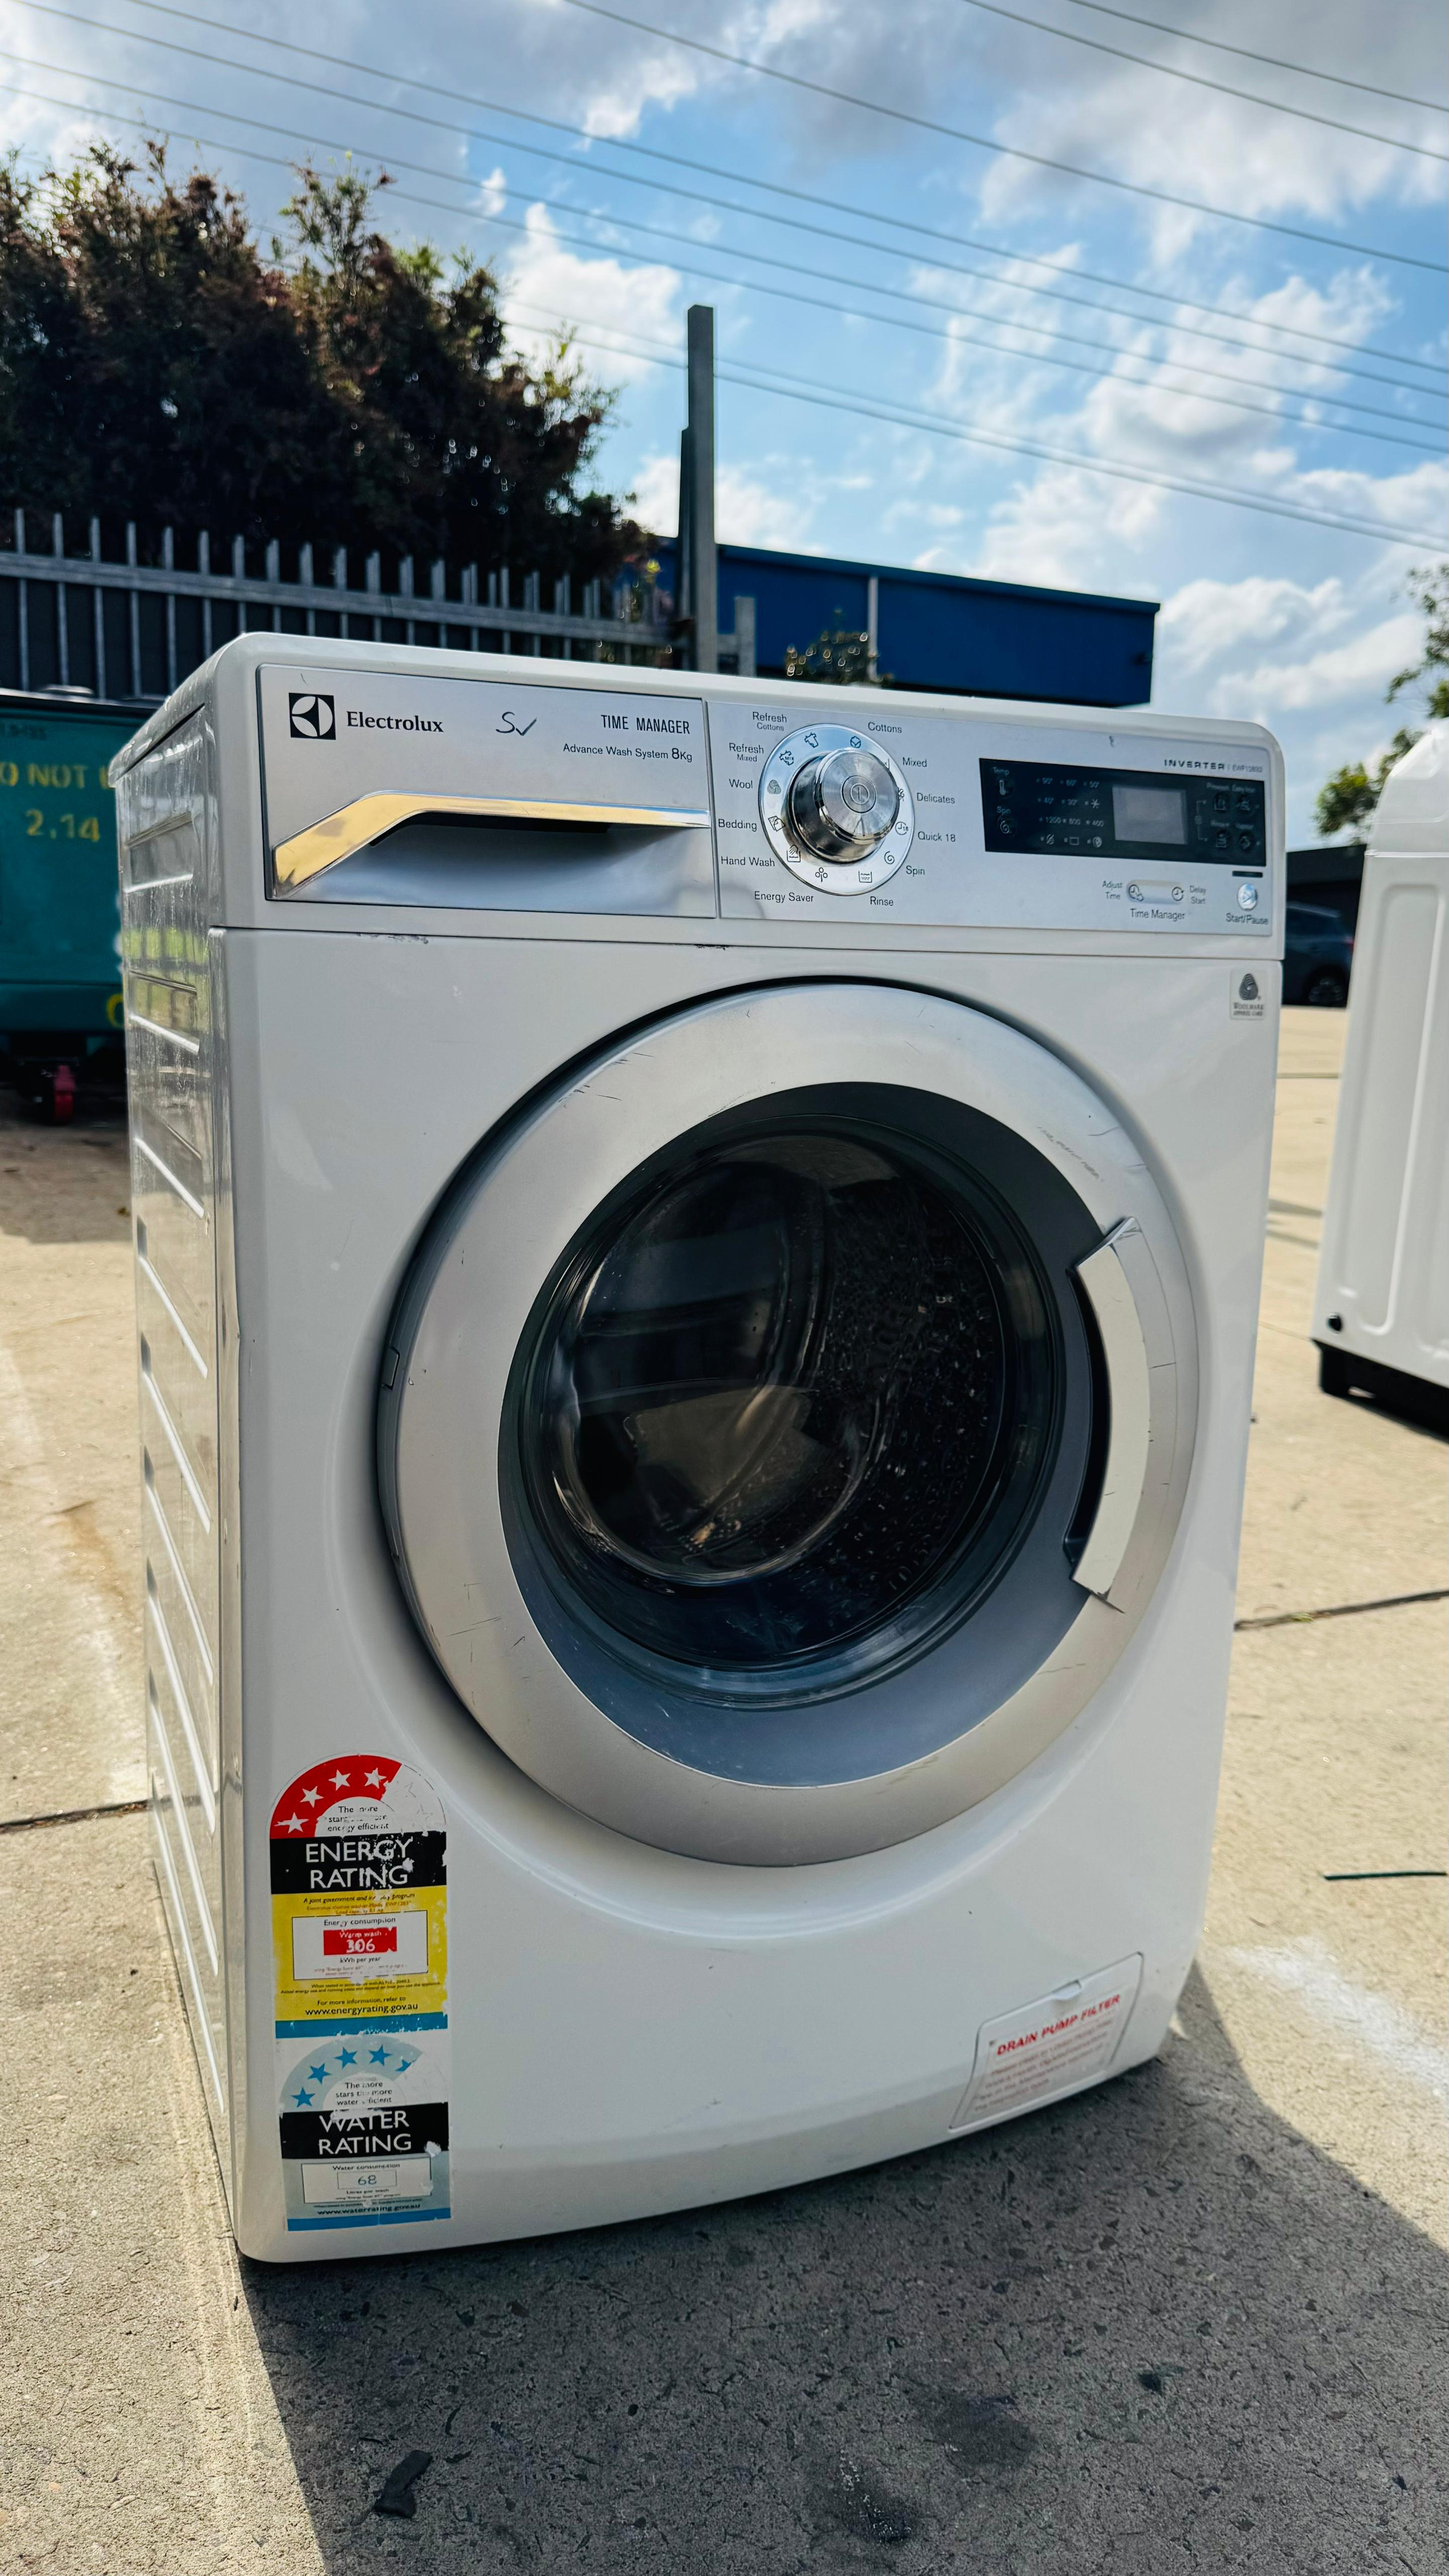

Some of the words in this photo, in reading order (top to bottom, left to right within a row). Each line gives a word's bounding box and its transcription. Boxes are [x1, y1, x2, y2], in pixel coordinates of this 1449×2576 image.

[347, 710, 444, 733] Electrolux
[753, 711, 787, 723] Refresh
[601, 714, 628, 731] TIME
[636, 716, 690, 735] MANAGER
[757, 722, 784, 731] Cottons
[868, 721, 902, 734] Cottons
[563, 743, 603, 754] Advance
[606, 745, 632, 757] Wash
[635, 747, 668, 761] System
[671, 747, 693, 763] 8Kg
[729, 743, 764, 754] Refresh
[737, 754, 758, 762] Mixed
[902, 757, 927, 768] Mixed
[1164, 759, 1225, 771] INVERTER
[28, 763, 88, 789] NOT
[993, 767, 1010, 776] Temp
[729, 778, 753, 789] Wool
[917, 792, 955, 804] Delicates
[26, 808, 100, 842] 2.14
[718, 819, 757, 832] Bedding
[918, 831, 942, 843] Quick
[945, 832, 956, 842] 18
[720, 855, 746, 866] Hand
[749, 857, 775, 867] Wash
[905, 865, 925, 877] Spin
[1102, 880, 1122, 890] Adjust
[1189, 885, 1206, 895] Delay
[754, 891, 786, 904] Energy
[788, 893, 814, 903] Saver
[870, 896, 894, 906] Rinse
[1105, 892, 1120, 900] Time
[1191, 897, 1205, 905] Start
[1130, 908, 1150, 919] Time
[1151, 910, 1185, 922] Manager
[1226, 913, 1269, 925] Start/Pause
[306, 1837, 413, 1863] ENERGY
[310, 1865, 408, 1889] RATING
[305, 2002, 419, 2016] www.energyrating.gov.au
[997, 2031, 1039, 2056] DRAIN
[1041, 2014, 1079, 2038] PUMP
[1081, 1994, 1120, 2022] FILTER
[319, 2110, 410, 2133] WATER
[318, 2133, 412, 2155] RATING
[358, 2175, 377, 2186] 68
